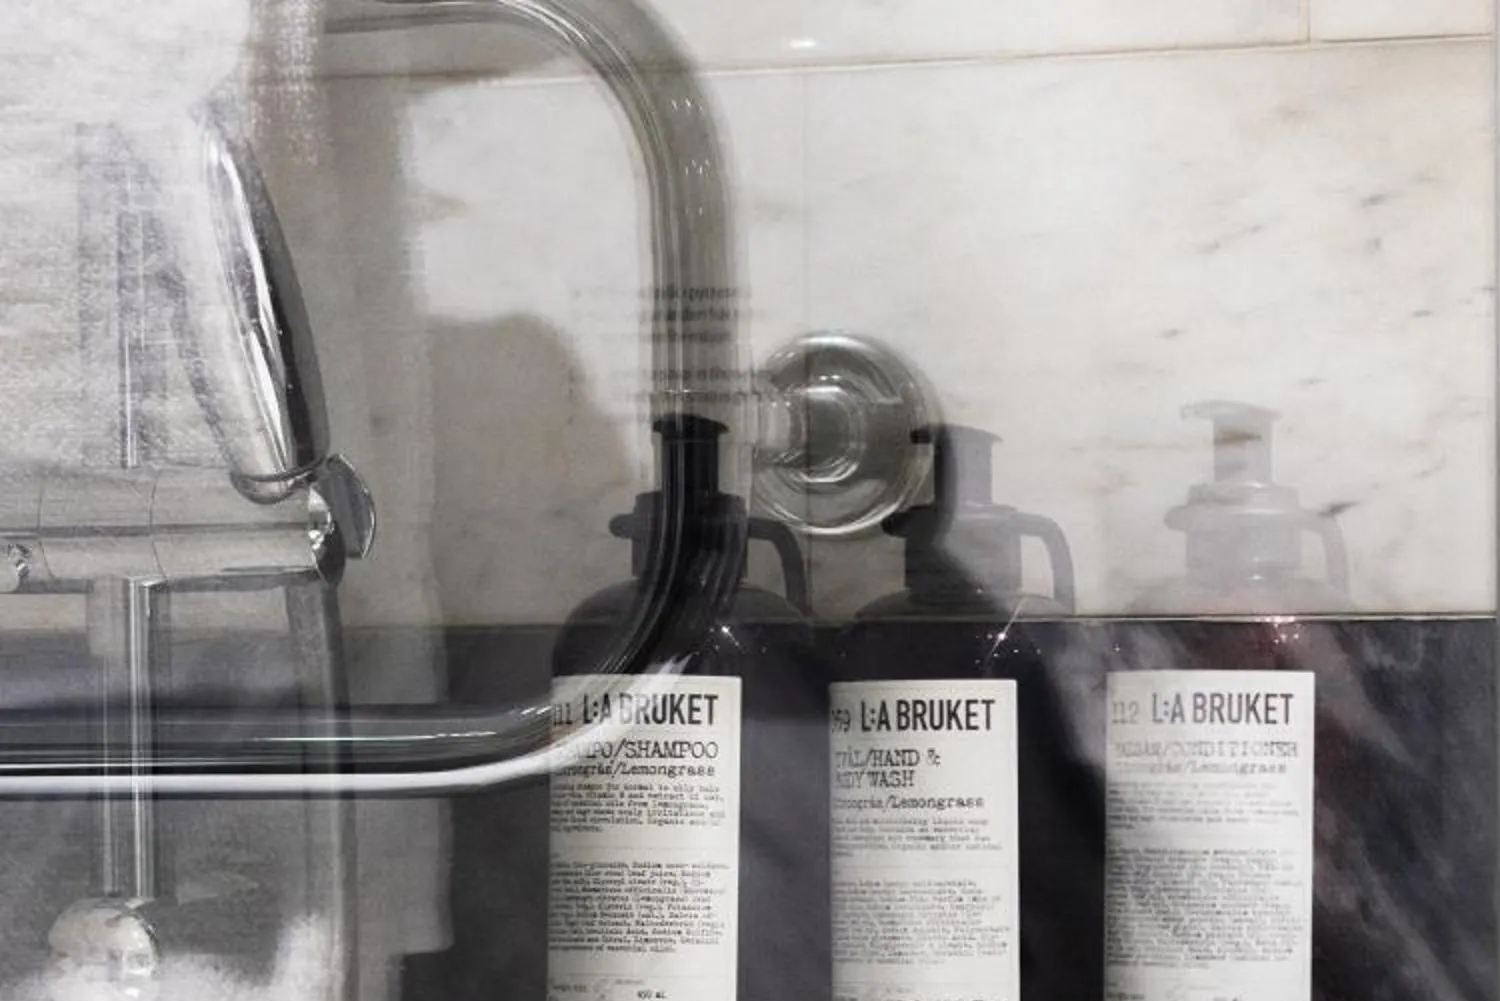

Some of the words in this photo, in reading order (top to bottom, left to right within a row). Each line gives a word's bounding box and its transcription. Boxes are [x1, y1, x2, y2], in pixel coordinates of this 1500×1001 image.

[583, 691, 611, 725] L:A
[619, 693, 719, 726] BRUKET
[861, 699, 892, 732] L:A
[896, 699, 997, 732] BRUKET
[1152, 692, 1185, 725] L:A
[1193, 692, 1294, 725] BRUKET
[867, 770, 916, 789] WASH
